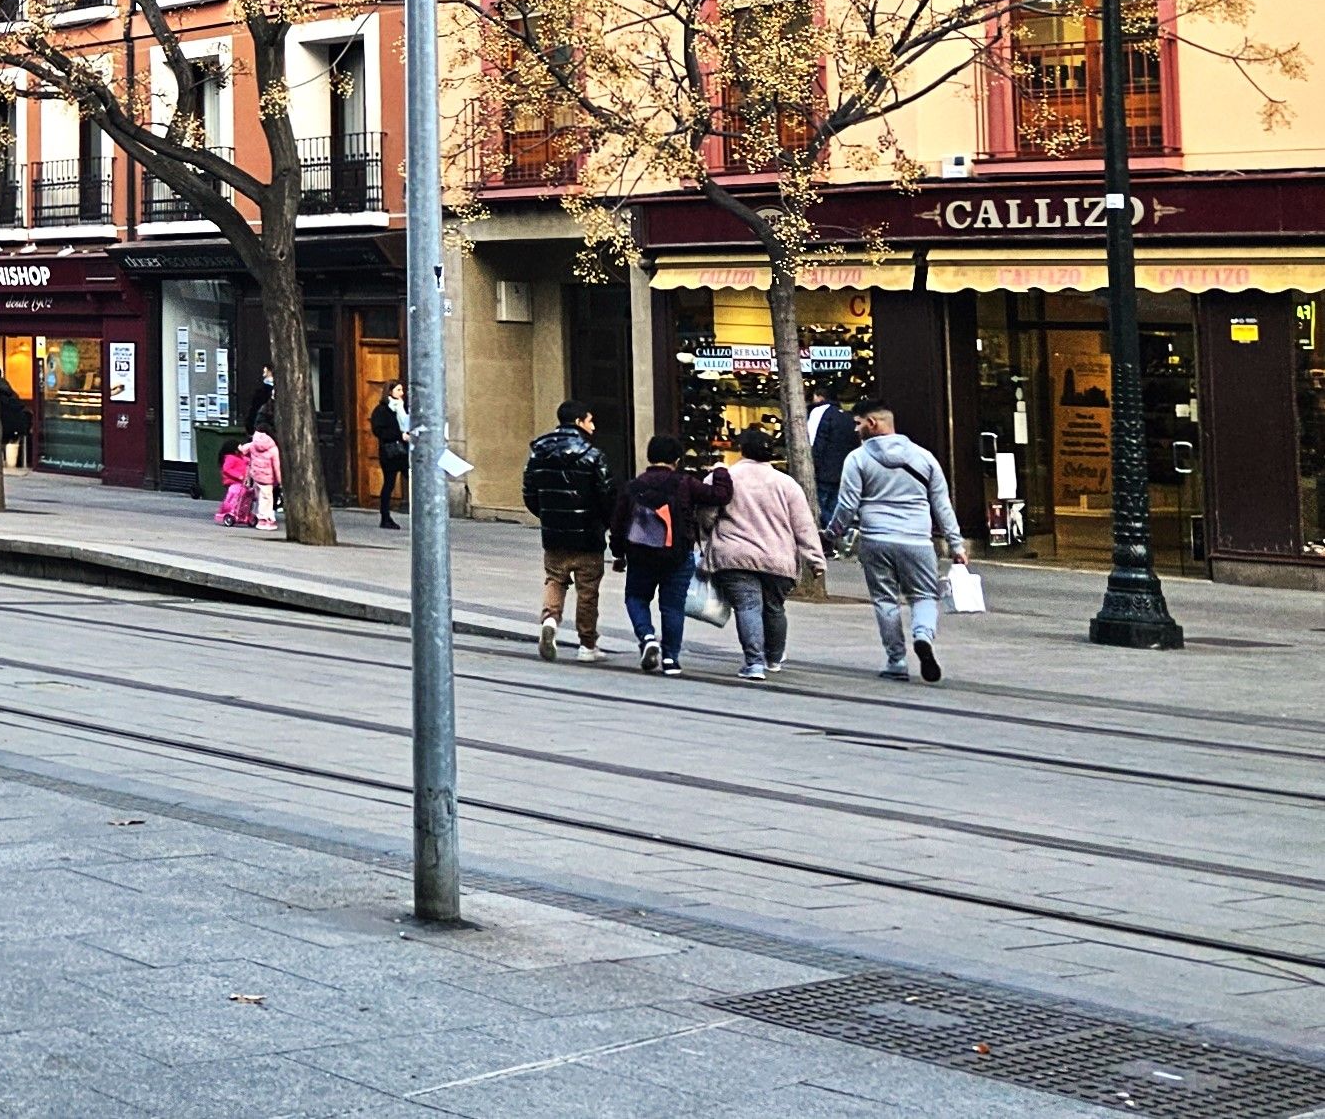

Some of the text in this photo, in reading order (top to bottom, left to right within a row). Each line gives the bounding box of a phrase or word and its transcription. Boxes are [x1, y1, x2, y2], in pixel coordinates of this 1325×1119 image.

[696, 347, 732, 357] CALLIZO
[734, 348, 770, 356] REBAJAS
[811, 347, 850, 357] CALLIZO
[696, 358, 732, 368] CALLIZO
[734, 360, 771, 370] REBAJAS
[812, 360, 851, 370] CALLIZO
